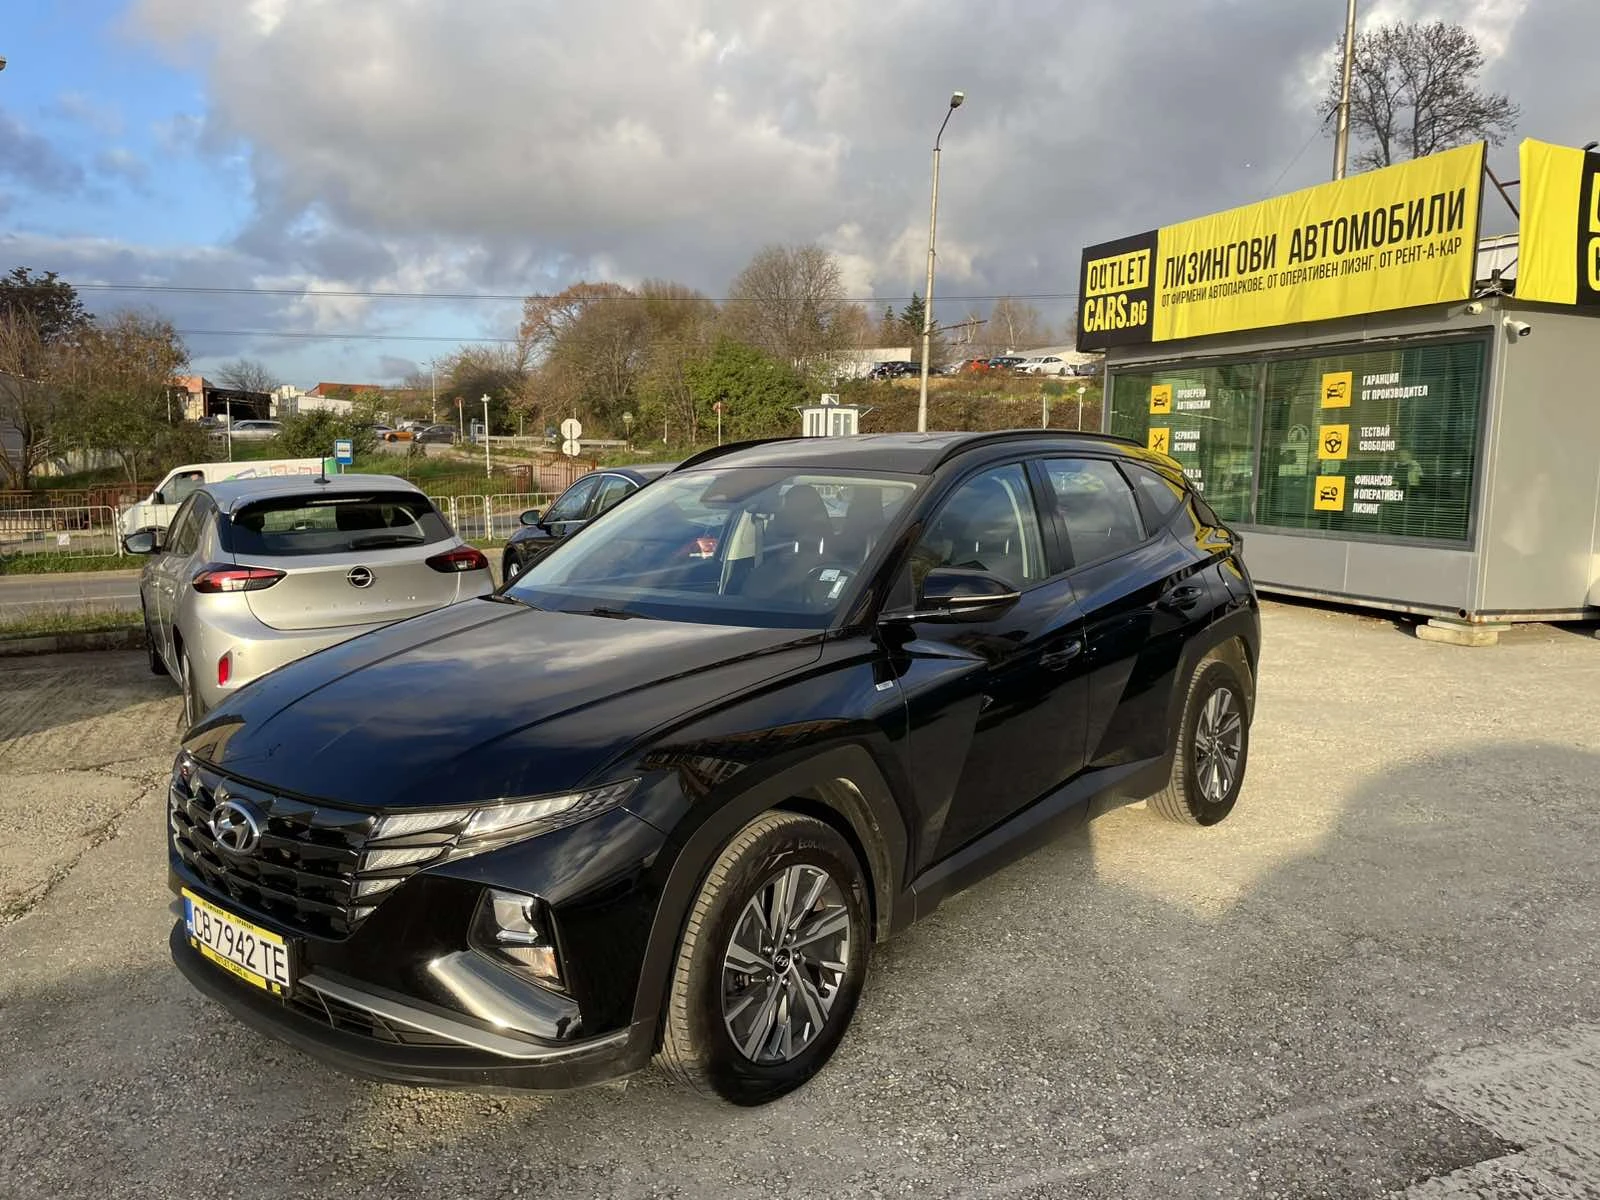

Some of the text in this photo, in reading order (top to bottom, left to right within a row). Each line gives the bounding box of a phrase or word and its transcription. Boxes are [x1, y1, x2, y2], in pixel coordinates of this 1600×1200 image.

[1162, 187, 1466, 290] ЛИЗИНГОВИ АВТОМОБИЛИ
[1090, 255, 1147, 292] OUTLET
[1161, 293, 1171, 308] ОТ
[1171, 286, 1208, 305] ФИРМЕНИ
[1267, 273, 1279, 289] ОТ
[1280, 262, 1339, 288] ОПЕРАТИВЕН
[1379, 250, 1393, 269] ОТ
[1395, 236, 1463, 266] РЕНТ-А-КАР
[1083, 293, 1148, 333] CARS.BG
[1362, 372, 1400, 386] ГАРАНЦИЯ
[1361, 385, 1429, 401] ОТ ПРОИЗВОДИТЕЛ
[1361, 424, 1391, 437] ТЕСТВАЙ
[1359, 440, 1396, 452] СВОБОДНО
[1354, 474, 1393, 486] ФИНАНСОВ
[1360, 488, 1404, 502] ОПЕРАТИВЕН
[1352, 502, 1380, 514] ЛИЗИНГ
